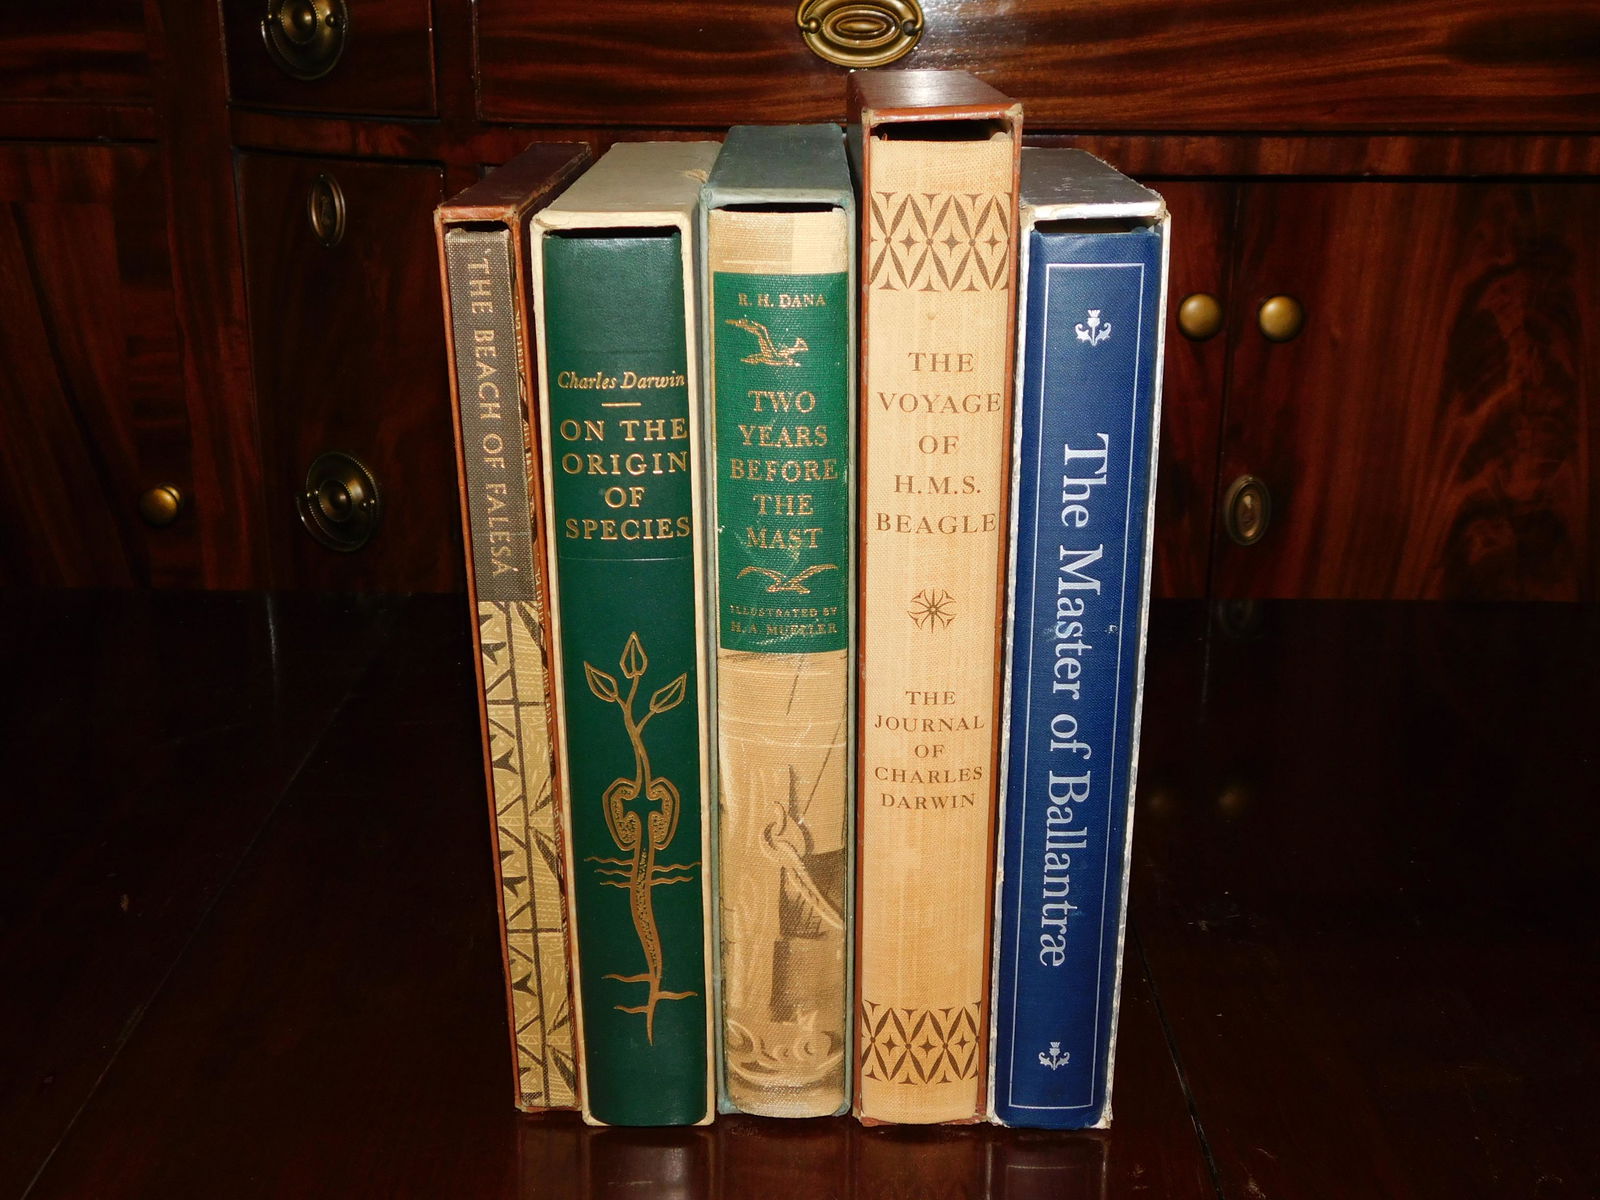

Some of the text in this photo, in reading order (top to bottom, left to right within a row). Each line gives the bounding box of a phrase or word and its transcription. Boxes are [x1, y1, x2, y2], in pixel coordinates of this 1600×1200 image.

[467, 257, 493, 313] THE
[738, 293, 827, 308] R. H. DANA
[908, 352, 974, 373] THE
[474, 329, 503, 419] BEACH
[557, 370, 685, 390] Charles Darwin
[748, 390, 816, 413] TWO
[877, 392, 1000, 414] VOYAGE
[560, 418, 688, 442] ON THE
[738, 424, 828, 448] YEARS
[482, 433, 506, 469] OF
[918, 435, 960, 454] OF
[561, 451, 688, 476] ORIGIN
[730, 458, 839, 483] BEFORE
[894, 474, 981, 495] H.M.S.
[604, 486, 645, 508] OF
[753, 494, 814, 516] THE
[565, 517, 691, 541] SPECIES
[876, 512, 997, 535] BEAGLE
[746, 527, 824, 549] MAST
[730, 605, 838, 618] ILLUSTRATED BY
[905, 691, 957, 706] THE
[1039, 432, 1110, 967] The Master of Ballantræ
[874, 714, 985, 733] JOURNAL
[914, 744, 945, 759] OF
[874, 766, 983, 784] CHARLES
[881, 792, 976, 810] DARWIN
